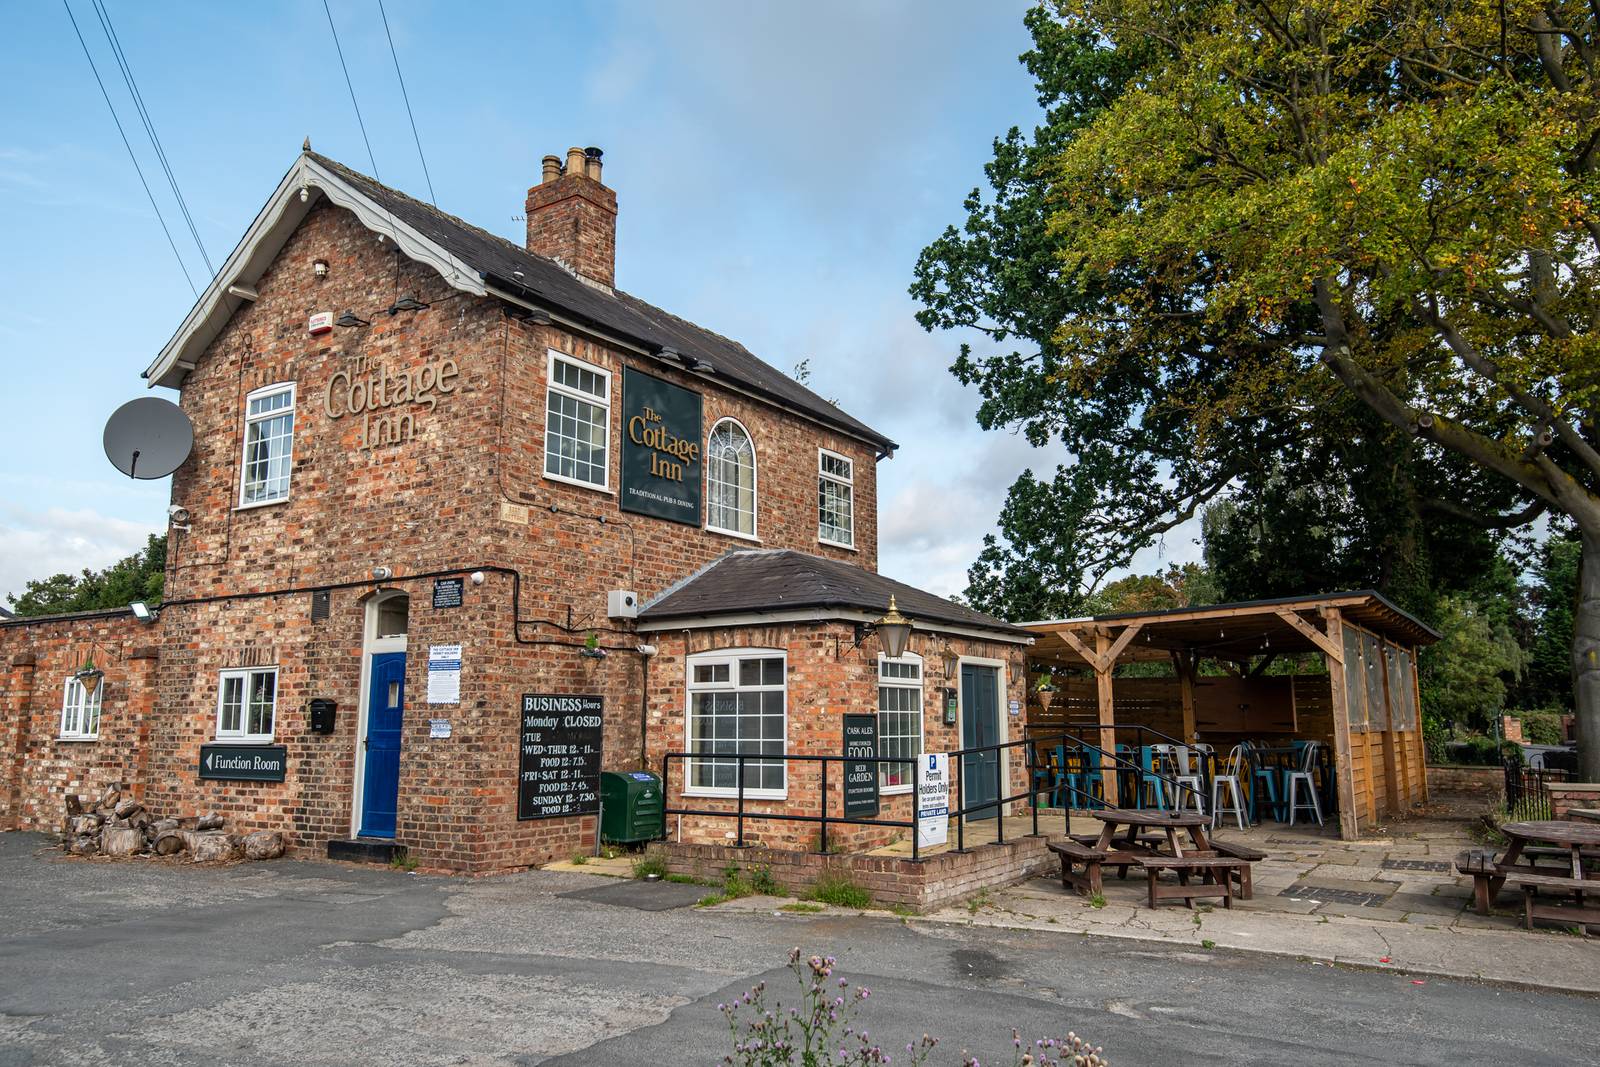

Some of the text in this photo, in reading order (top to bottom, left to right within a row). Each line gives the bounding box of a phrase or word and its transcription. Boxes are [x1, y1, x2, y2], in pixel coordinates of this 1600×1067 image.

[352, 353, 382, 374] The
[324, 359, 458, 418] Cottage
[642, 406, 662, 423] The
[360, 414, 415, 450] Inn
[629, 416, 699, 466] Cottage
[650, 452, 682, 482] Inn
[629, 488, 662, 502] TRADITIONAL
[663, 496, 673, 504] PUB
[677, 500, 694, 509] DINING
[525, 697, 600, 712] BUSINESS Hours
[526, 715, 601, 730] Monday CLOSED
[847, 726, 873, 735] CASK ALES
[525, 733, 542, 742] TUE
[848, 747, 873, 757] FOOD
[215, 754, 280, 771] Function Room
[540, 757, 560, 767] FOOD
[849, 773, 873, 783] GARDEN
[926, 770, 942, 781] Permit
[539, 783, 560, 793] FOOD
[919, 782, 948, 794] Holders Only
[533, 795, 564, 805] SUNDAY
[542, 806, 560, 815] FOOD
[921, 810, 936, 818] PRIVATE
